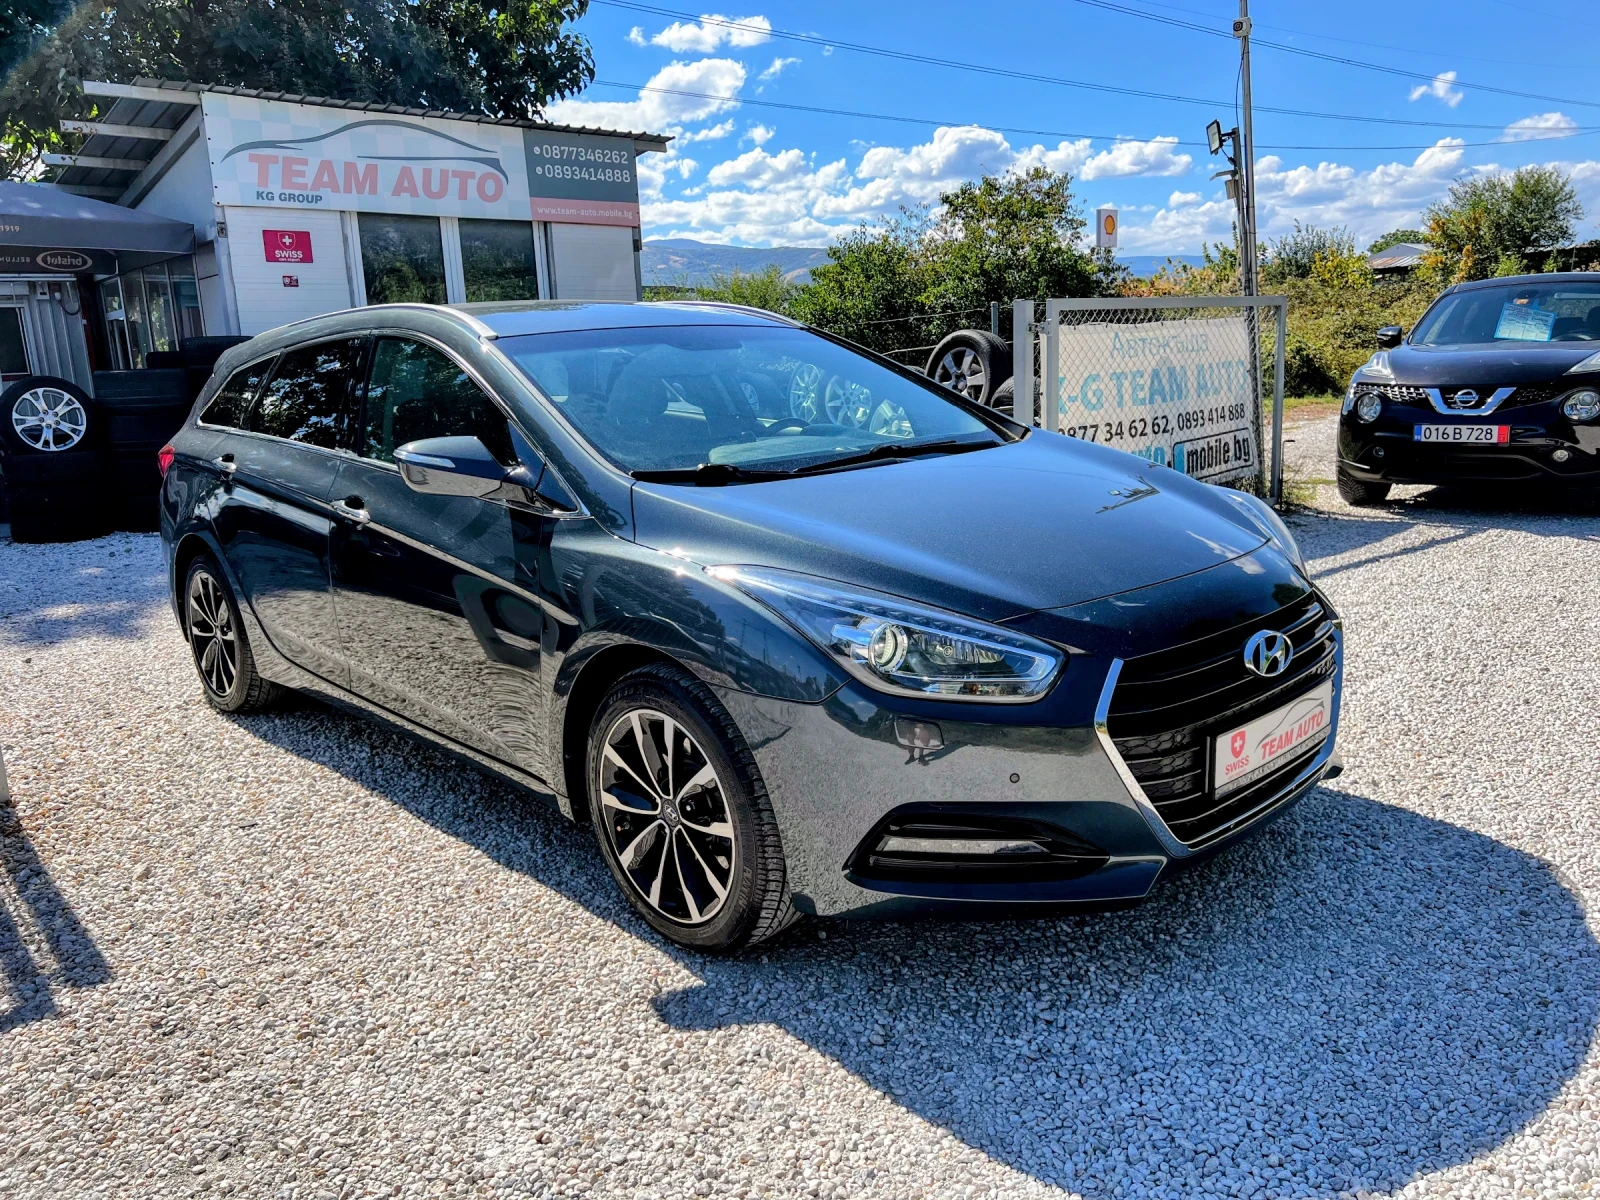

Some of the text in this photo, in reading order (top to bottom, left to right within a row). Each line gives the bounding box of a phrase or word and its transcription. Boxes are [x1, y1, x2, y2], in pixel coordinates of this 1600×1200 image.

[543, 145, 629, 164] 0877346262
[248, 153, 504, 203] TEAM AUTO
[545, 164, 631, 183] 0893414888
[256, 190, 323, 204] KG GROUP
[536, 206, 633, 219] www.team-auto.mobile.bg
[274, 249, 303, 259] SWISS
[1110, 365, 1190, 409] TEAM
[1196, 359, 1249, 399] AUTO
[1104, 421, 1125, 442] 34
[1128, 417, 1148, 439] 62
[1177, 409, 1205, 432] 0893
[1208, 405, 1226, 426] 414
[1228, 402, 1245, 422] 888
[1423, 427, 1450, 440] 016
[1453, 427, 1462, 440] B
[1466, 427, 1493, 440] 728
[1186, 434, 1251, 474] mobile.bg
[1261, 710, 1324, 760] TEAM AUTO
[1225, 755, 1250, 775] SWISS
